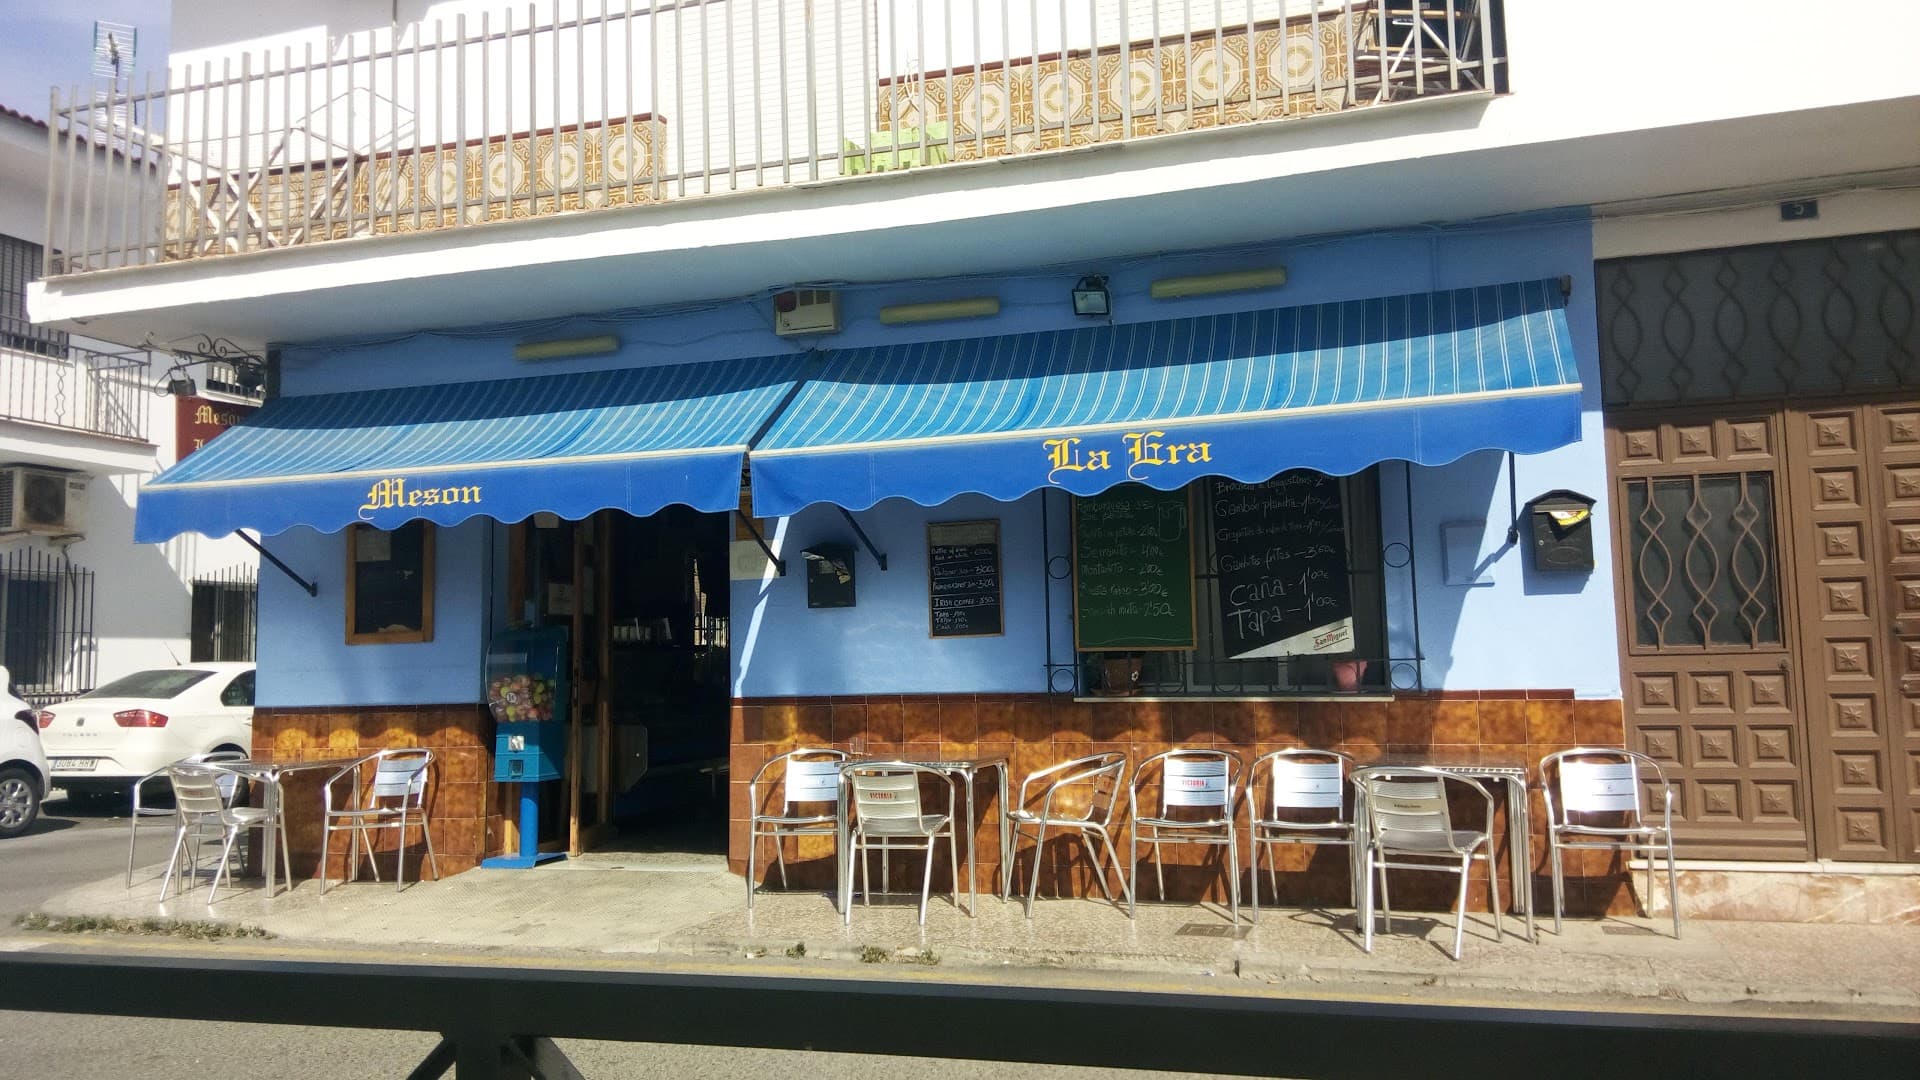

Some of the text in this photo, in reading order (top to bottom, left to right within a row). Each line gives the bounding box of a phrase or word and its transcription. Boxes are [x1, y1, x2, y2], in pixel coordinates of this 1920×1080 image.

[1042, 430, 1213, 485] La Era
[358, 478, 483, 520] Meson
[1230, 575, 1287, 606] Caña
[1227, 605, 1283, 640] Tapa
